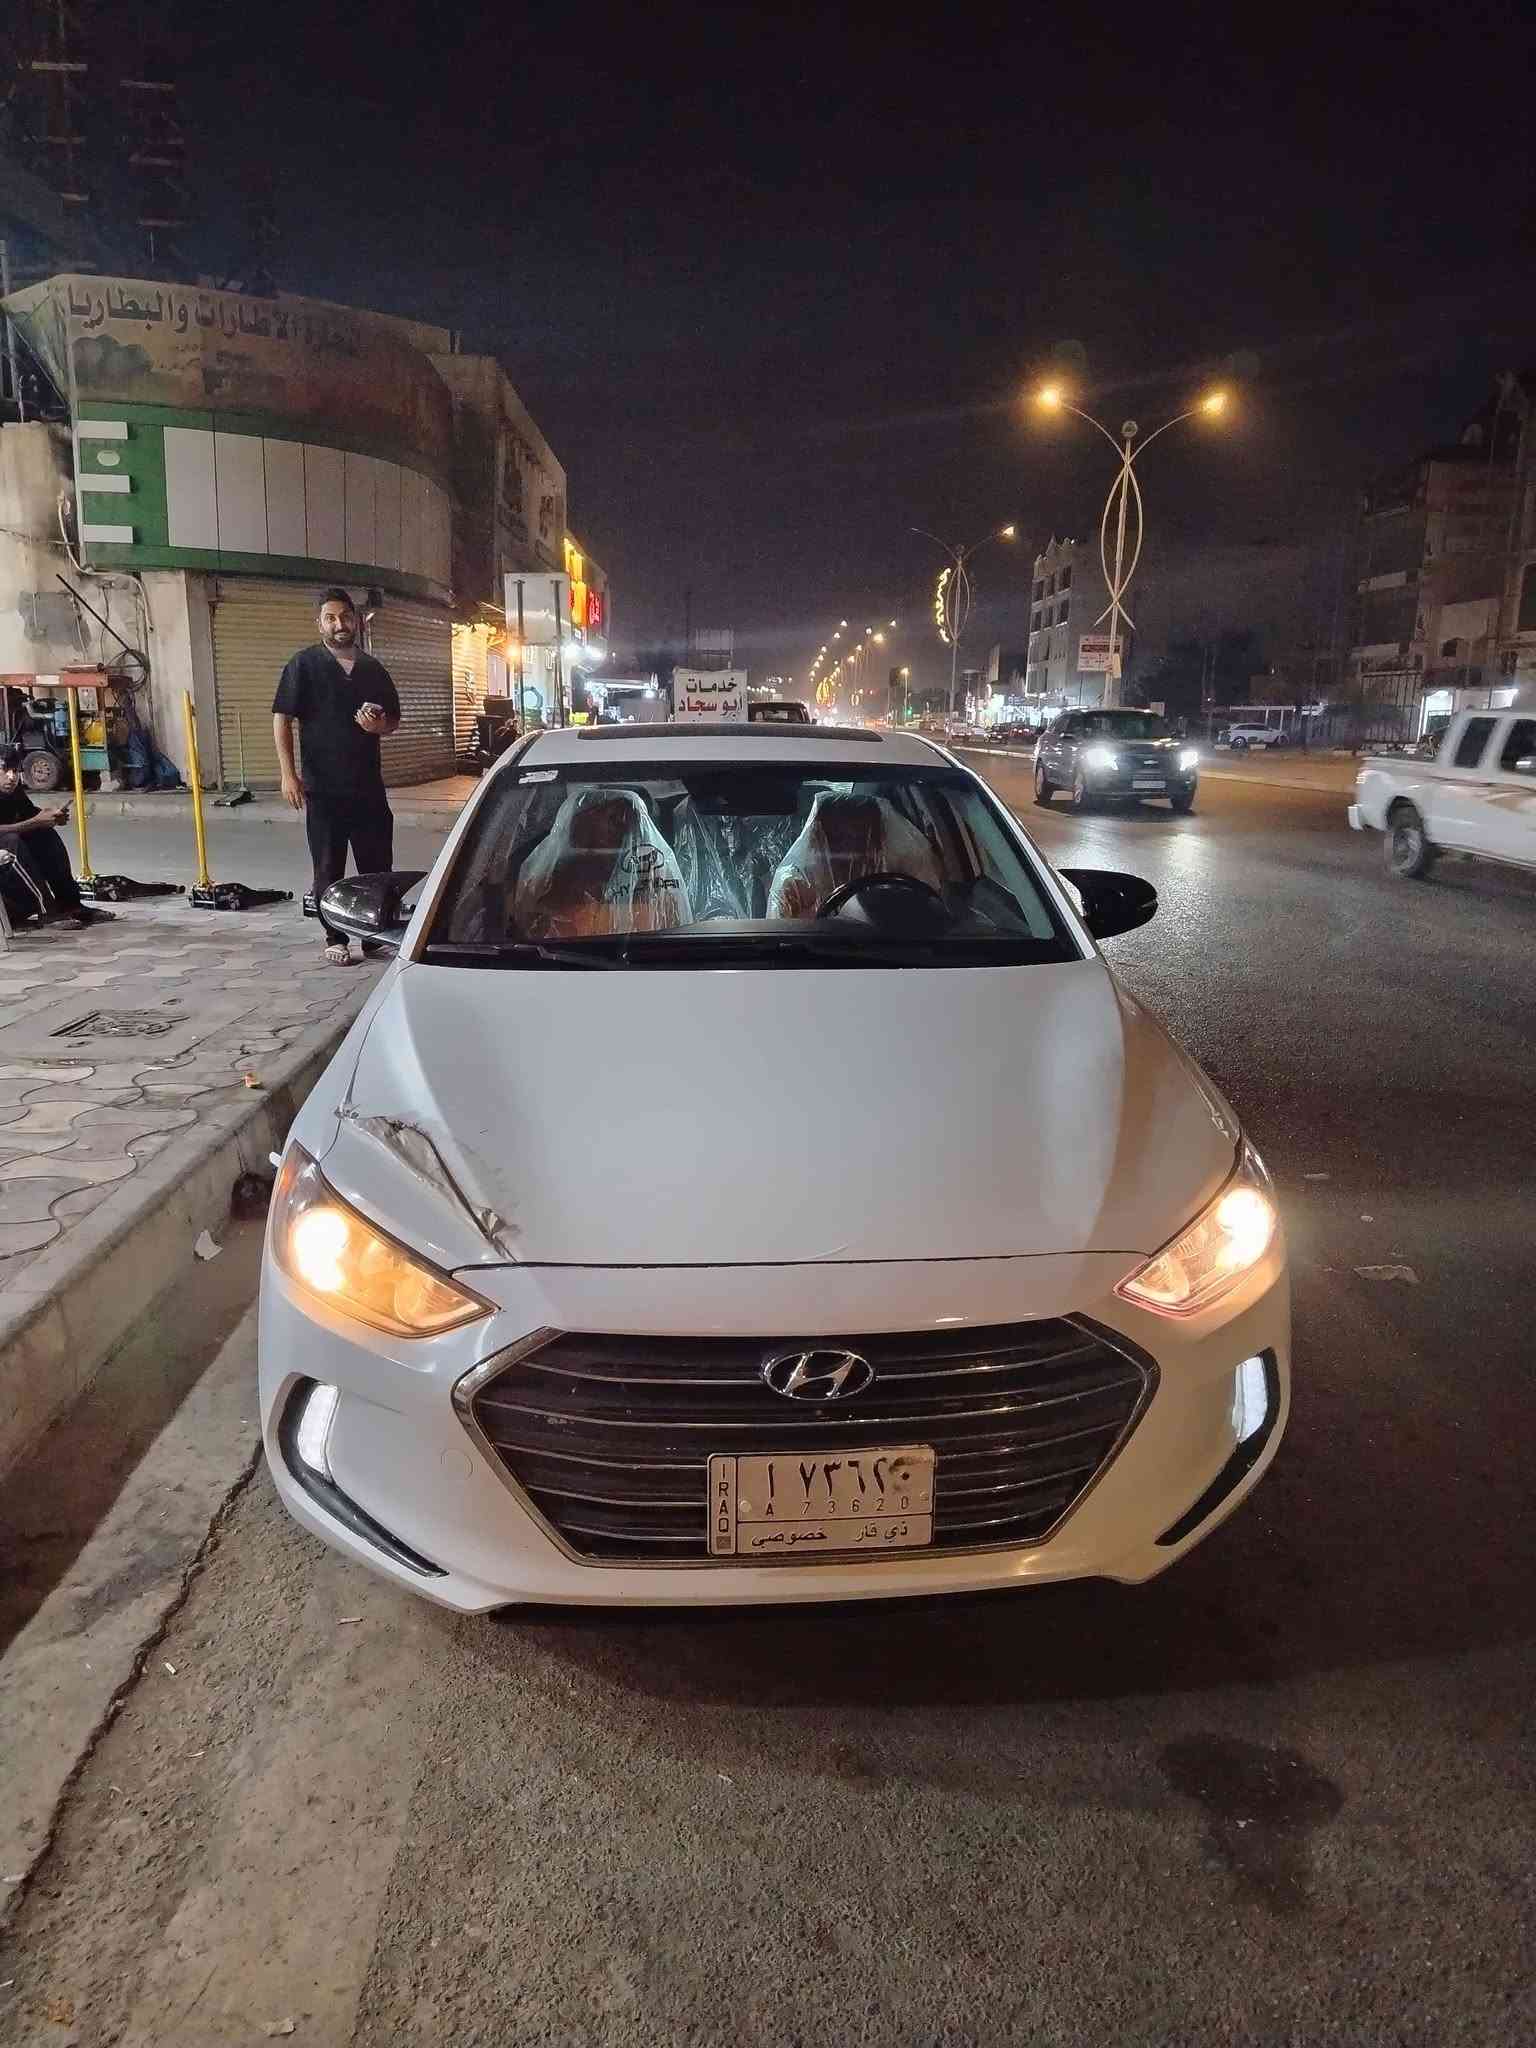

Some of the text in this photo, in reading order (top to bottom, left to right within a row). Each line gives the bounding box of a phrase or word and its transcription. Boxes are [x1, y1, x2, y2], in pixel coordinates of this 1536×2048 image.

[686, 677, 737, 694] خدمات
[678, 696, 718, 716] سجاد
[718, 1463, 729, 1533] IRAQ
[854, 1521, 878, 1542] قار
[884, 1520, 908, 1543] ذي
